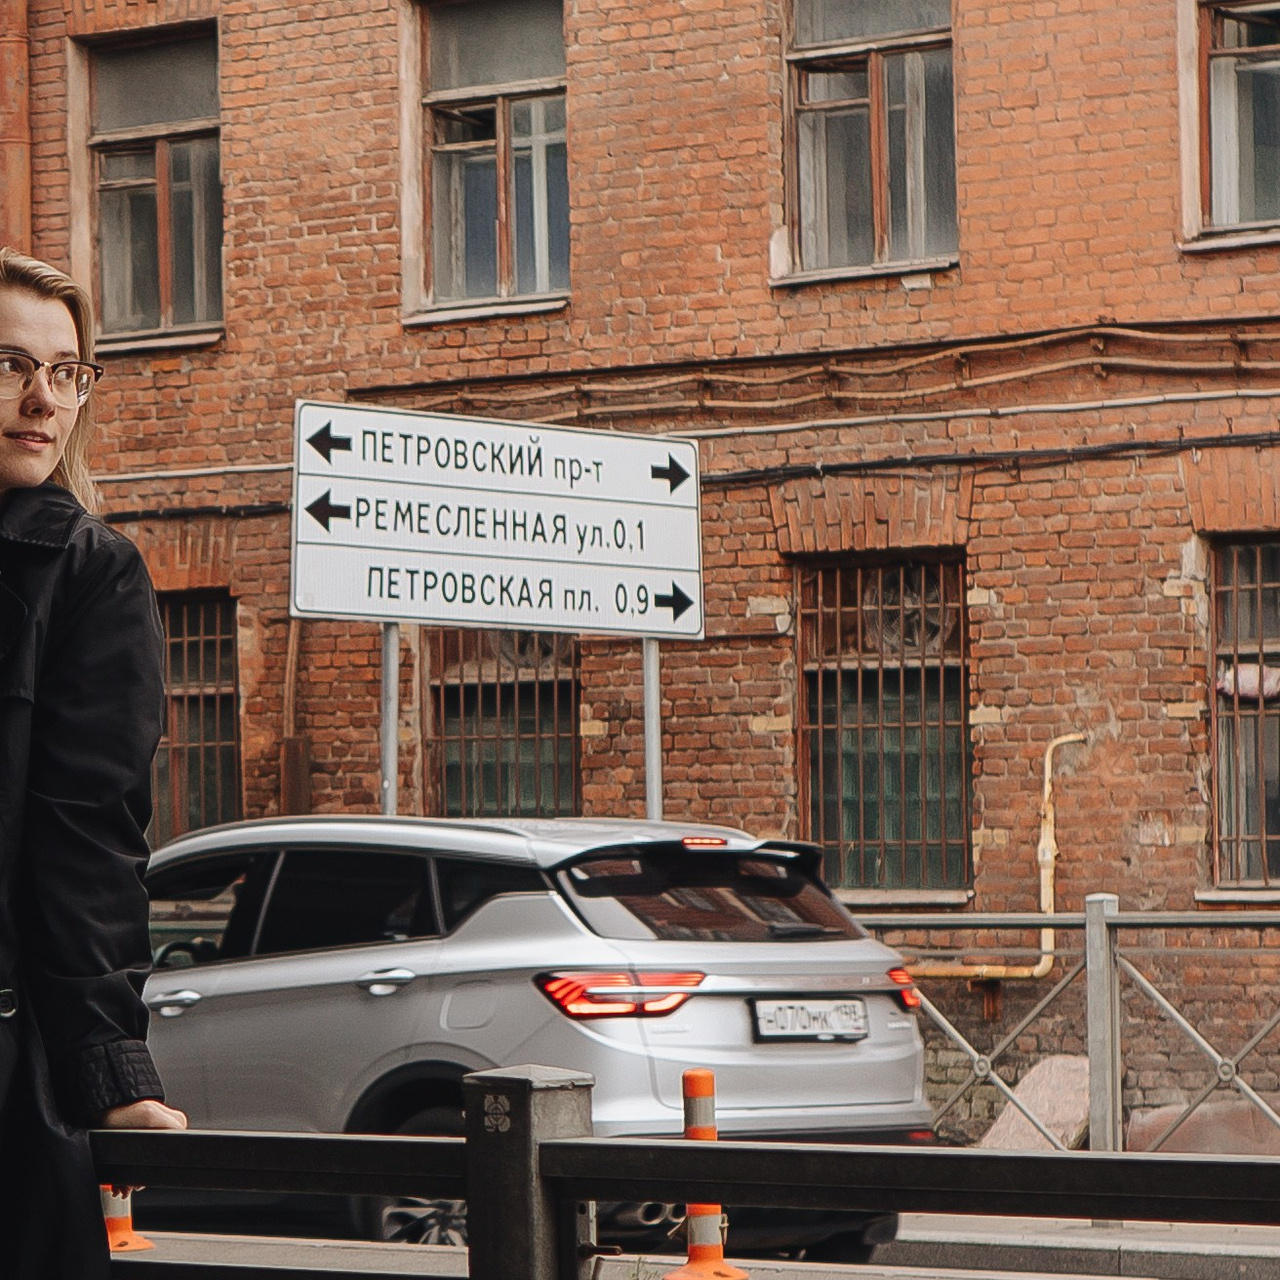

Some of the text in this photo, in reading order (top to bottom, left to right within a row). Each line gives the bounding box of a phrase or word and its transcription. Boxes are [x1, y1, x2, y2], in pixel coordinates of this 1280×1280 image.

[361, 429, 604, 489] ПЕТРОВСКИЙ пр-т
[355, 497, 567, 545] РЕМЕСЛЕННАЯ
[367, 566, 650, 619] ПЕТРОВСКАЯ пл. 0,9
